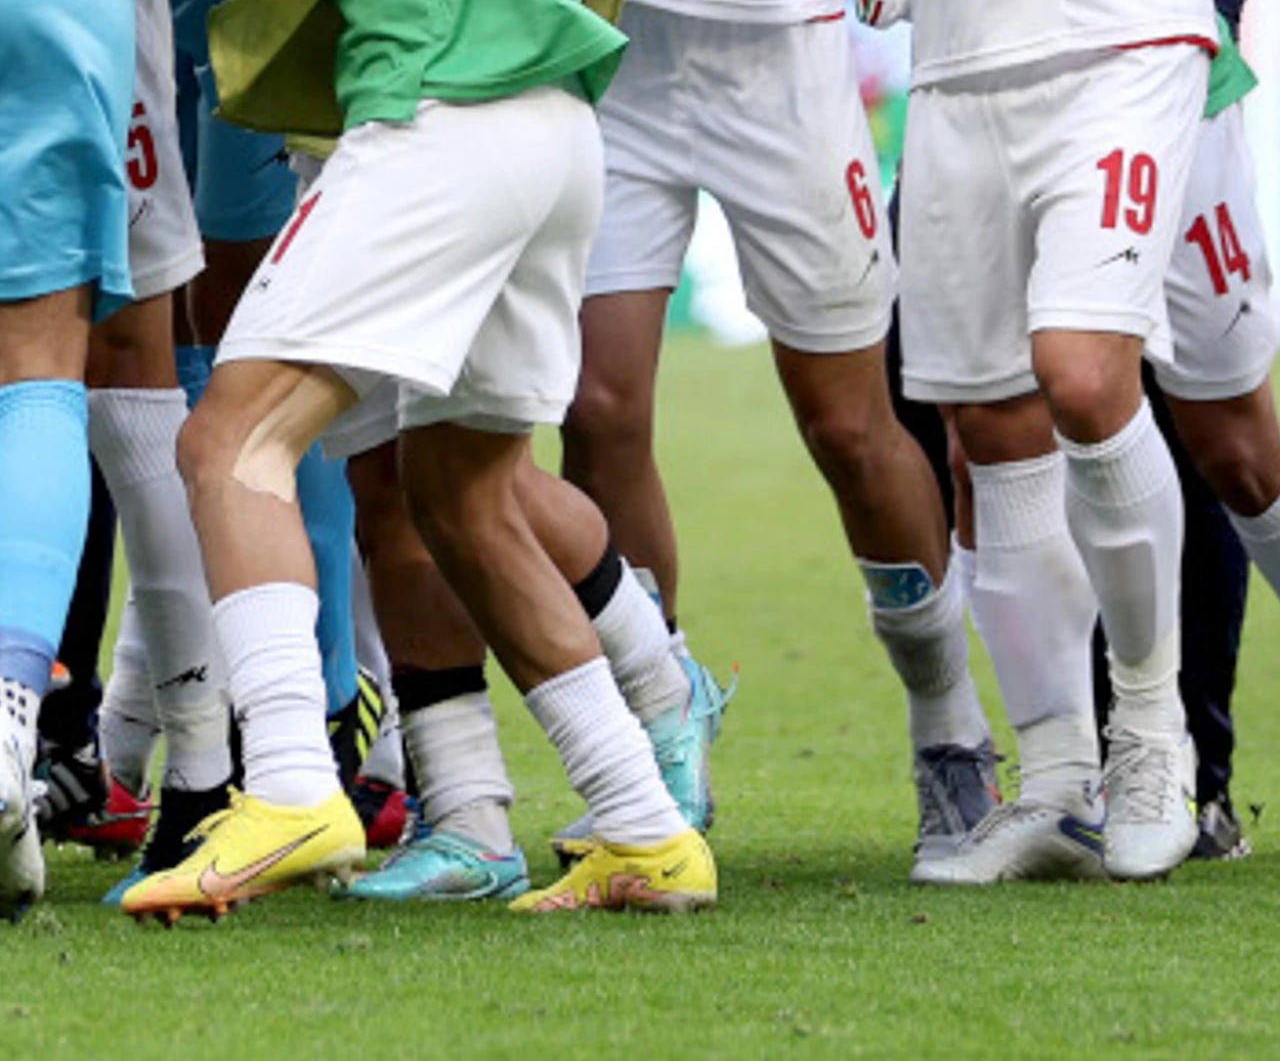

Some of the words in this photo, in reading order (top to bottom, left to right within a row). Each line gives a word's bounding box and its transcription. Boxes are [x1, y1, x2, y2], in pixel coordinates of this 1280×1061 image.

[846, 158, 877, 241] 6
[1096, 147, 1158, 236] 19
[1185, 201, 1252, 296] 14
